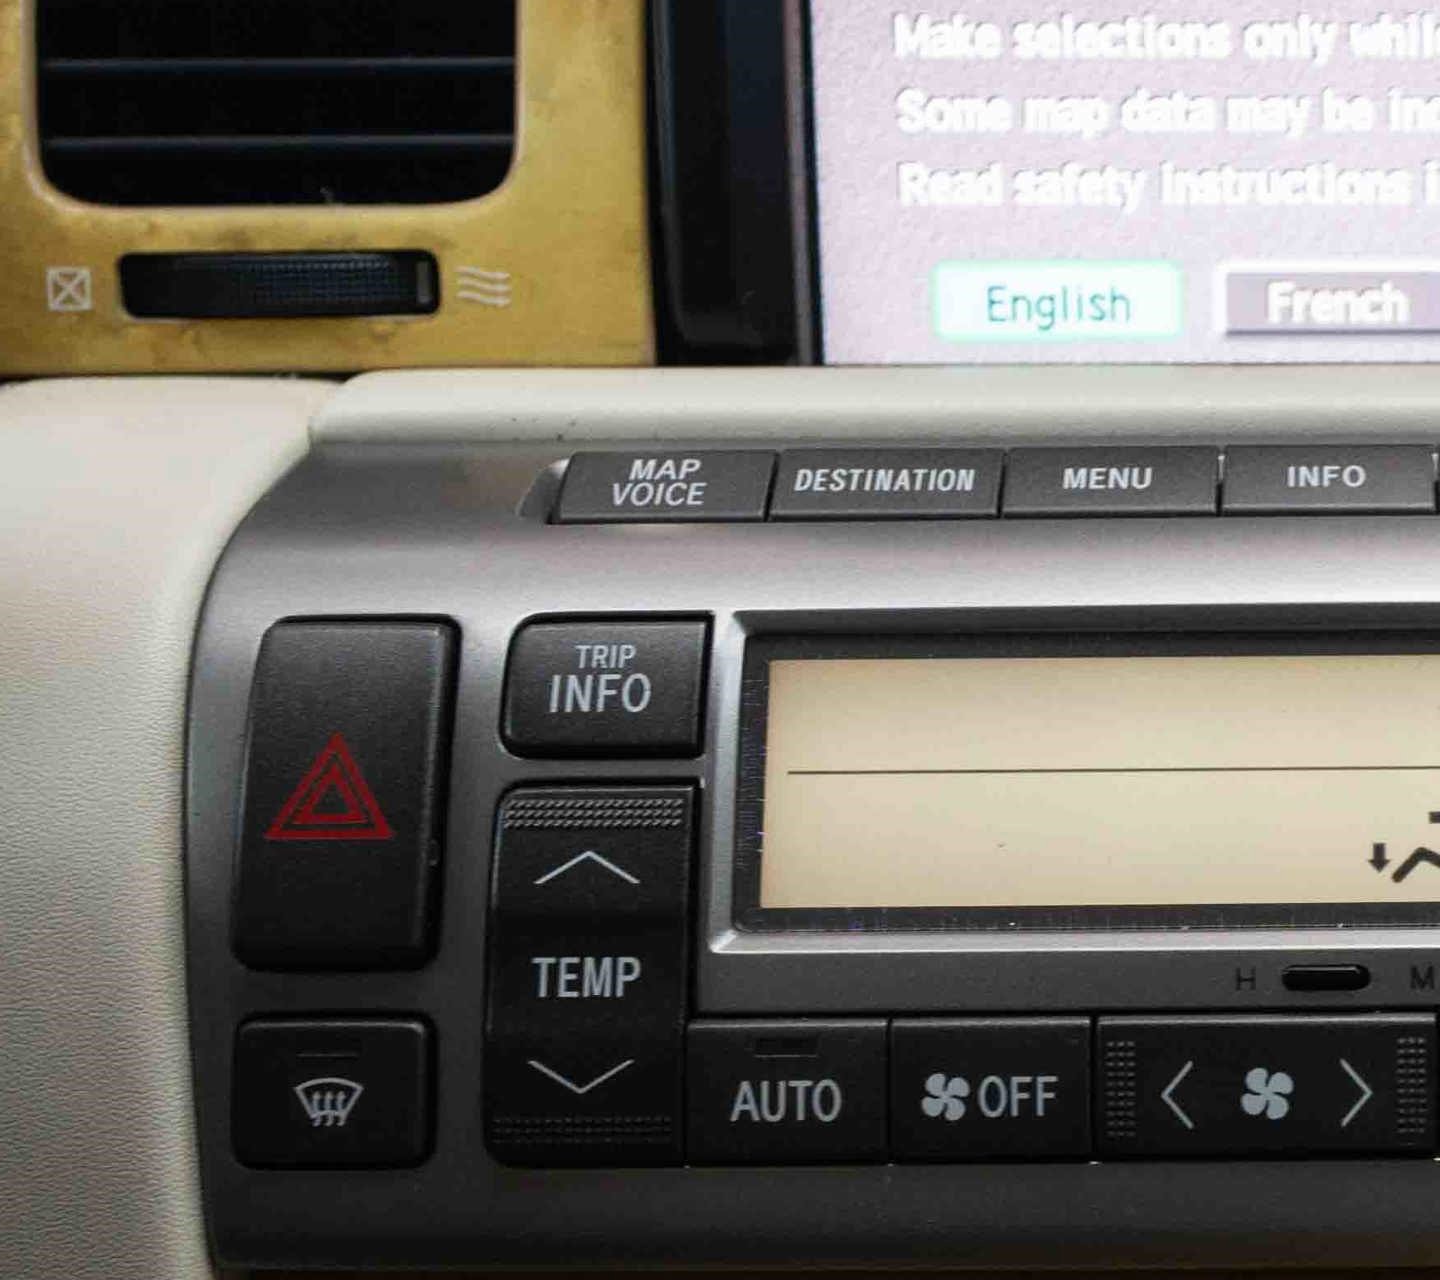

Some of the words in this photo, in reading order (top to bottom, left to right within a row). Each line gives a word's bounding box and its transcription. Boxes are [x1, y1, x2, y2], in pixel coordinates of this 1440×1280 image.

[894, 13, 1002, 58] Make
[1013, 13, 1232, 58] selections
[1243, 13, 1338, 65] only
[896, 88, 1011, 132] Some
[1023, 96, 1109, 140] map
[1121, 88, 1217, 132] data
[1227, 97, 1311, 140] may
[1322, 88, 1374, 131] be
[897, 161, 1004, 205] Read
[1014, 161, 1145, 213] safety
[1161, 161, 1413, 205] instructions
[987, 286, 1131, 331] English
[1267, 280, 1410, 324] French
[628, 457, 700, 480] MAP
[794, 468, 976, 492] DESTINATION
[1063, 467, 1153, 490] MENU
[1286, 465, 1367, 489] INFO
[611, 482, 707, 506] VOICE
[576, 645, 636, 668] TRIP
[548, 673, 651, 713] INFO
[531, 956, 640, 998] TEMP
[1235, 968, 1255, 989] H
[1410, 966, 1434, 988] M
[730, 1079, 842, 1122] AUTO
[978, 1075, 1058, 1118] OFF
